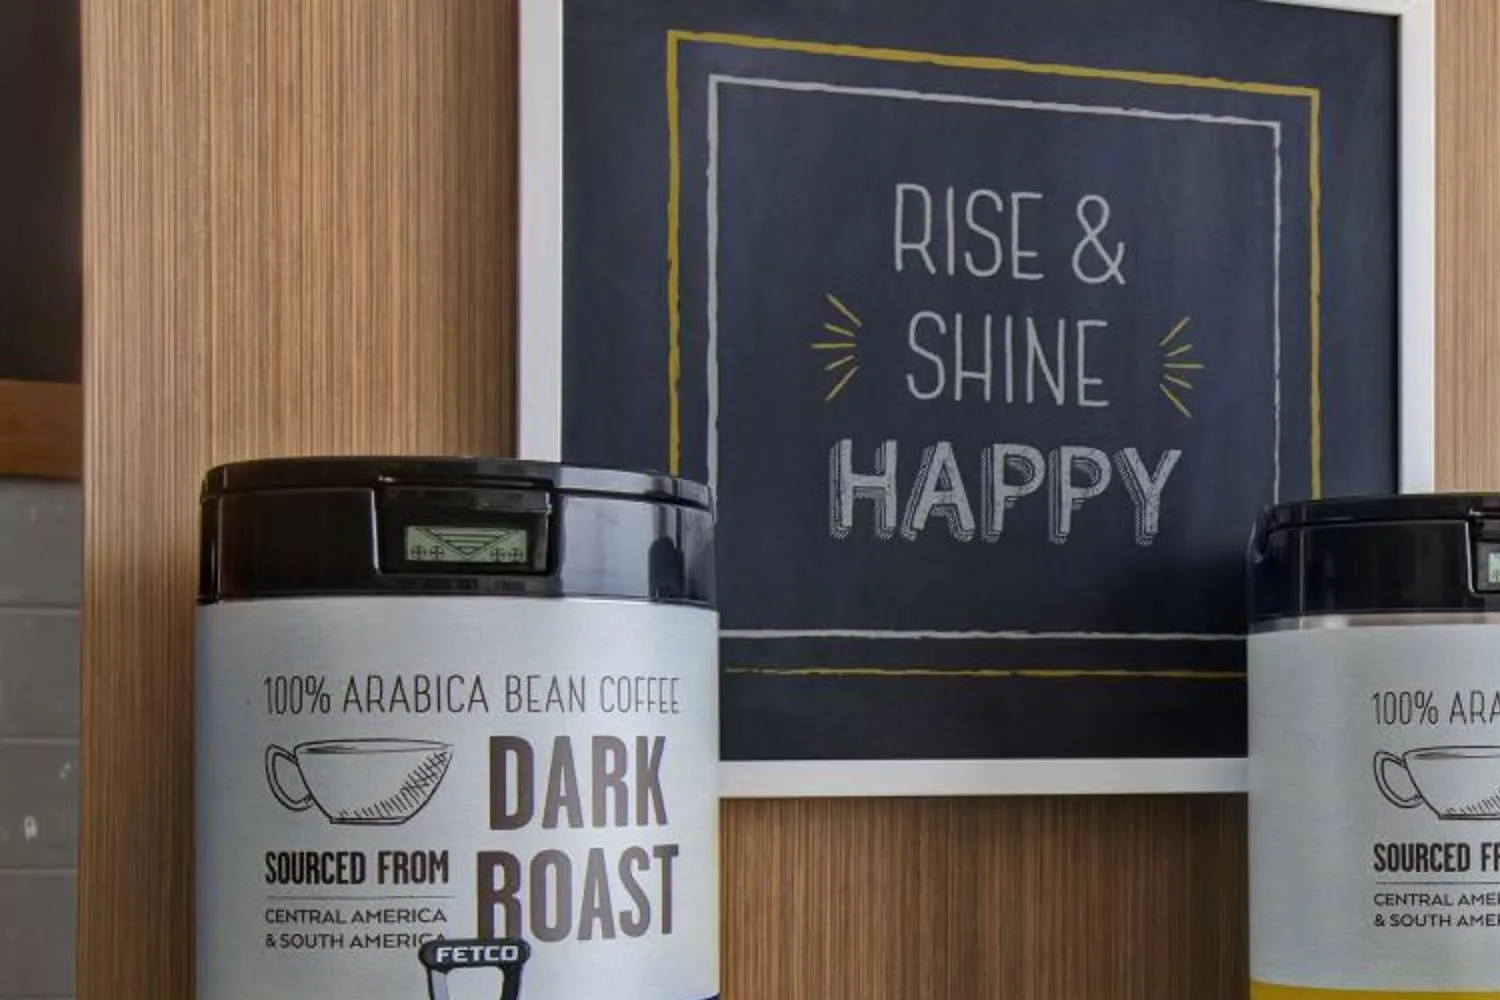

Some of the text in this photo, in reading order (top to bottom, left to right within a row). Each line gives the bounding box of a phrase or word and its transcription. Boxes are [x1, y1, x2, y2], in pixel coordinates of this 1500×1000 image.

[892, 182, 1127, 286] RISE &
[905, 310, 1111, 408] SHINE
[828, 437, 1183, 547] HAPPY
[263, 673, 680, 715] 100% ARABICA BEAN COFFEE
[1371, 689, 1438, 726] 100%
[489, 735, 669, 831] DARK
[265, 849, 449, 885] SOURCED FROM
[1373, 842, 1471, 873] SOURCED
[476, 844, 680, 943] ROAST
[1373, 893, 1454, 907] CENTRAL
[265, 907, 448, 924] CENTRAL AMERICA
[1375, 913, 1386, 927] &
[1389, 913, 1451, 928] SOUTH
[265, 934, 277, 947] &
[279, 933, 344, 949] SOUTH
[436, 944, 520, 964] FETCO
